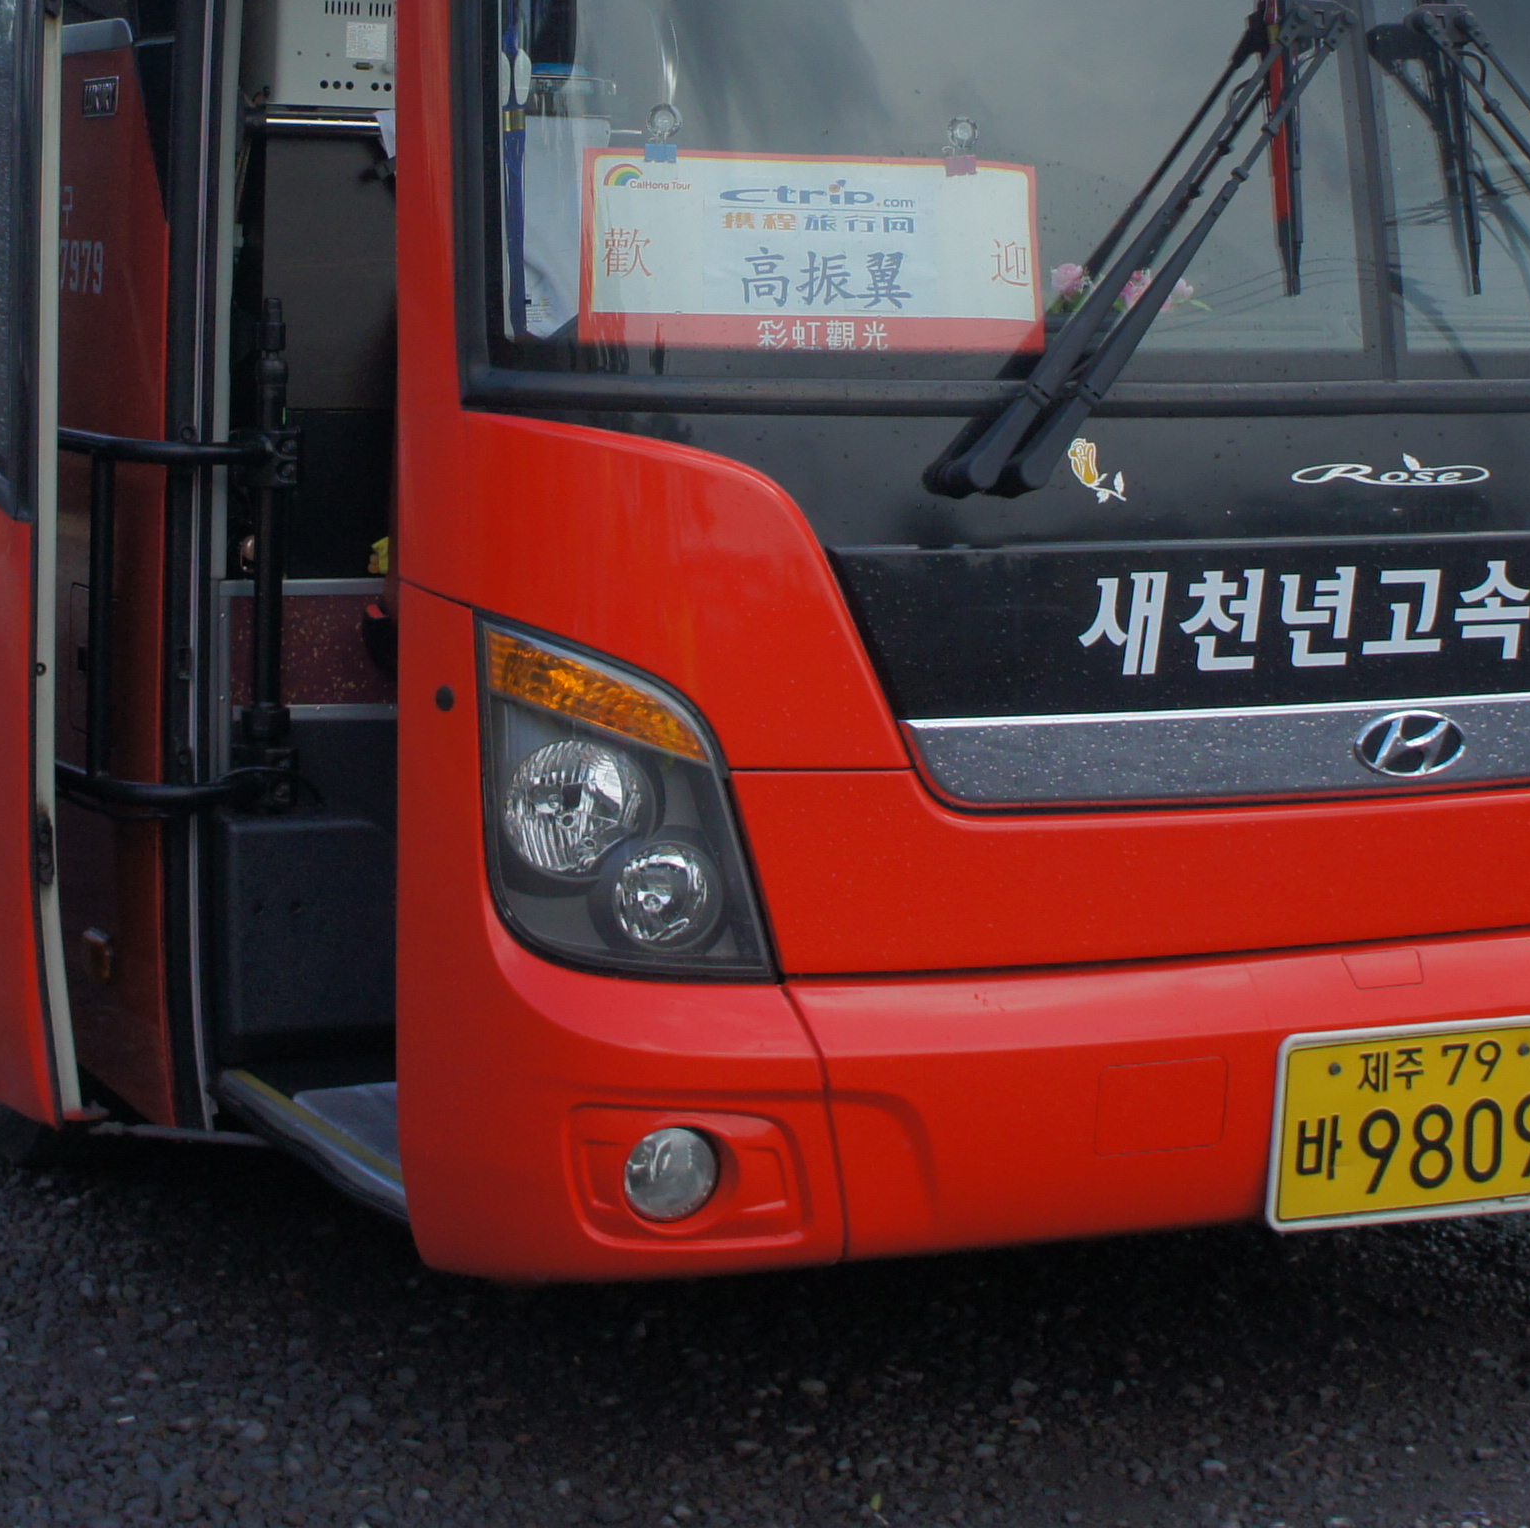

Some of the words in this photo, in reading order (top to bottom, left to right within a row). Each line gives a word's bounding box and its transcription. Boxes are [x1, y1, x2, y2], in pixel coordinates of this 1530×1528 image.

[672, 180, 692, 191] Tour
[741, 245, 913, 310] 高振翼
[991, 238, 1030, 288] 迎
[1291, 457, 1491, 487] Rose
[1357, 1046, 1425, 1093] 제주
[1441, 1039, 1502, 1086] 79
